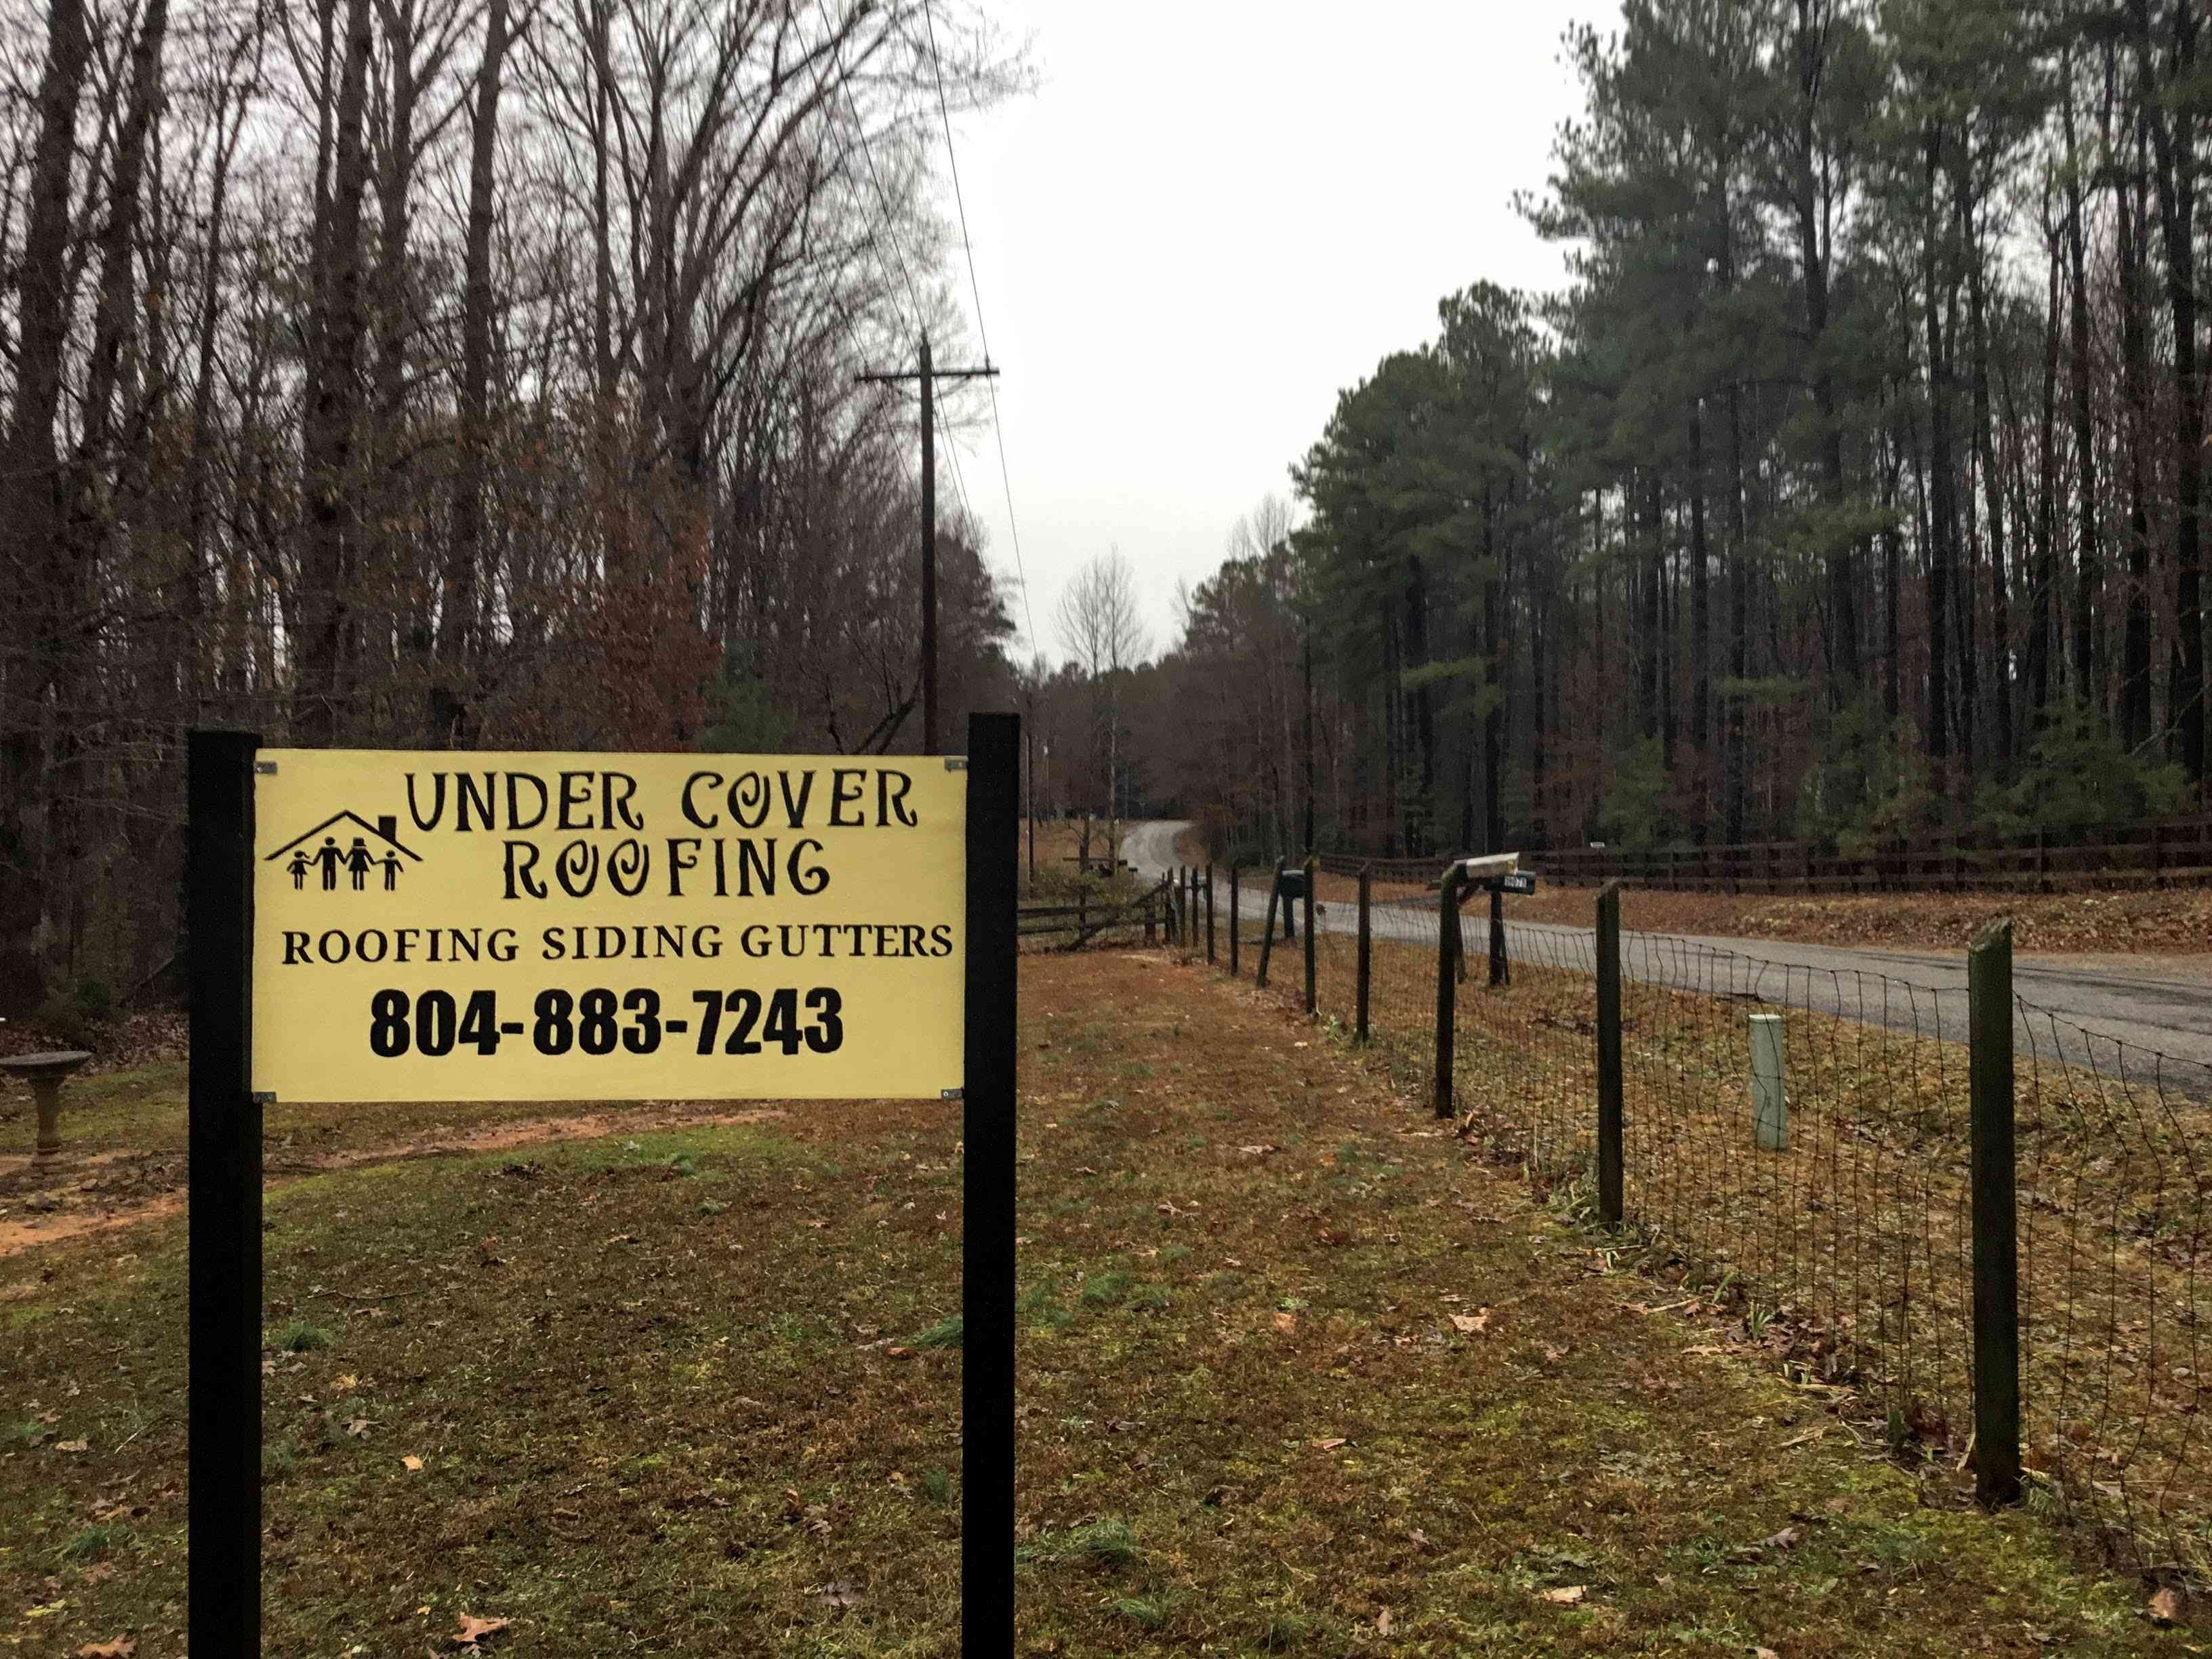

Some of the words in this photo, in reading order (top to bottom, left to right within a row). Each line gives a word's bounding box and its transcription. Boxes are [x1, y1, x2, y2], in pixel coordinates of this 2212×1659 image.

[405, 771, 644, 832] UNDER
[681, 769, 918, 830] COVER
[502, 838, 830, 899] ROOFING
[281, 928, 519, 965] ROOFING
[542, 924, 723, 960] SIDING
[740, 924, 953, 958] GUTTERS
[369, 987, 844, 1058] 804-883-7243
